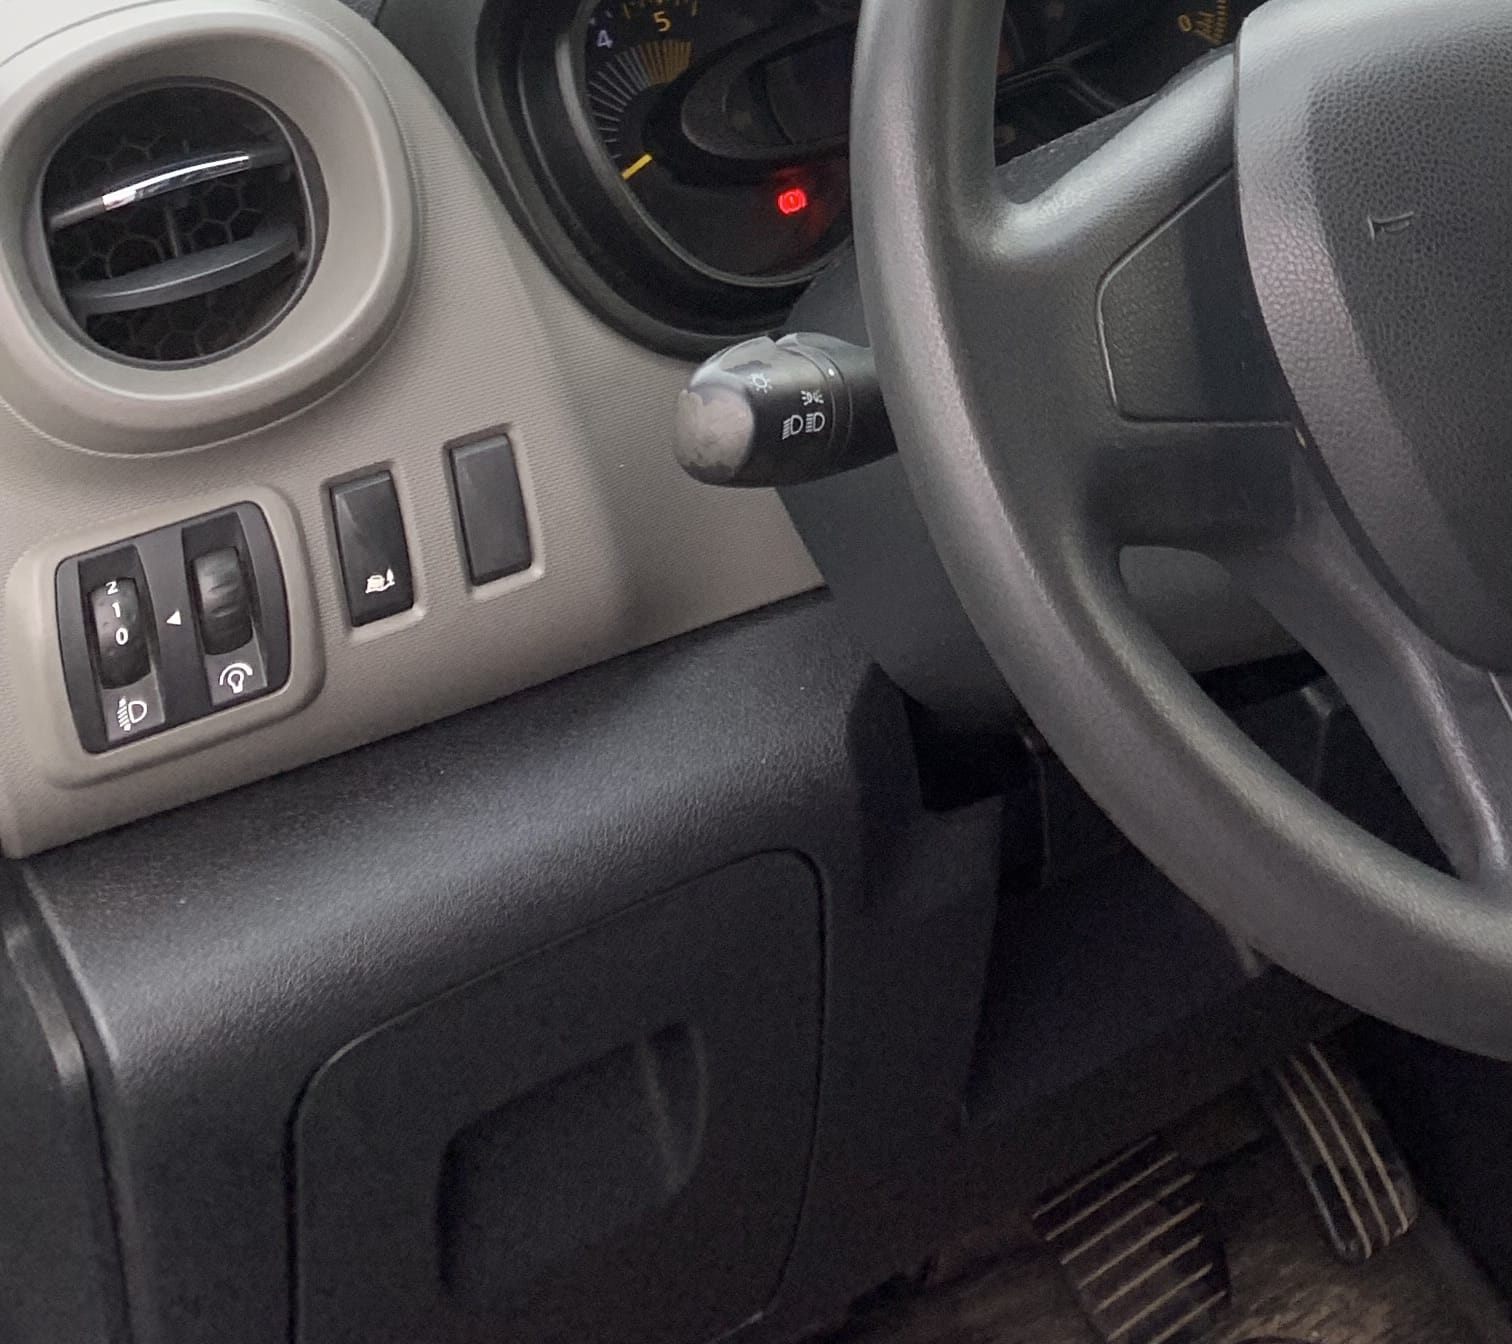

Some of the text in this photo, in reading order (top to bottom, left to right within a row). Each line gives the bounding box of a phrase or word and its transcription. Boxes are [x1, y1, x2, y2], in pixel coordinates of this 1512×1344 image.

[653, 11, 672, 32] 5
[597, 29, 613, 49] 4
[105, 580, 119, 595] 2
[111, 601, 121, 618] 1
[115, 627, 129, 646] 0
